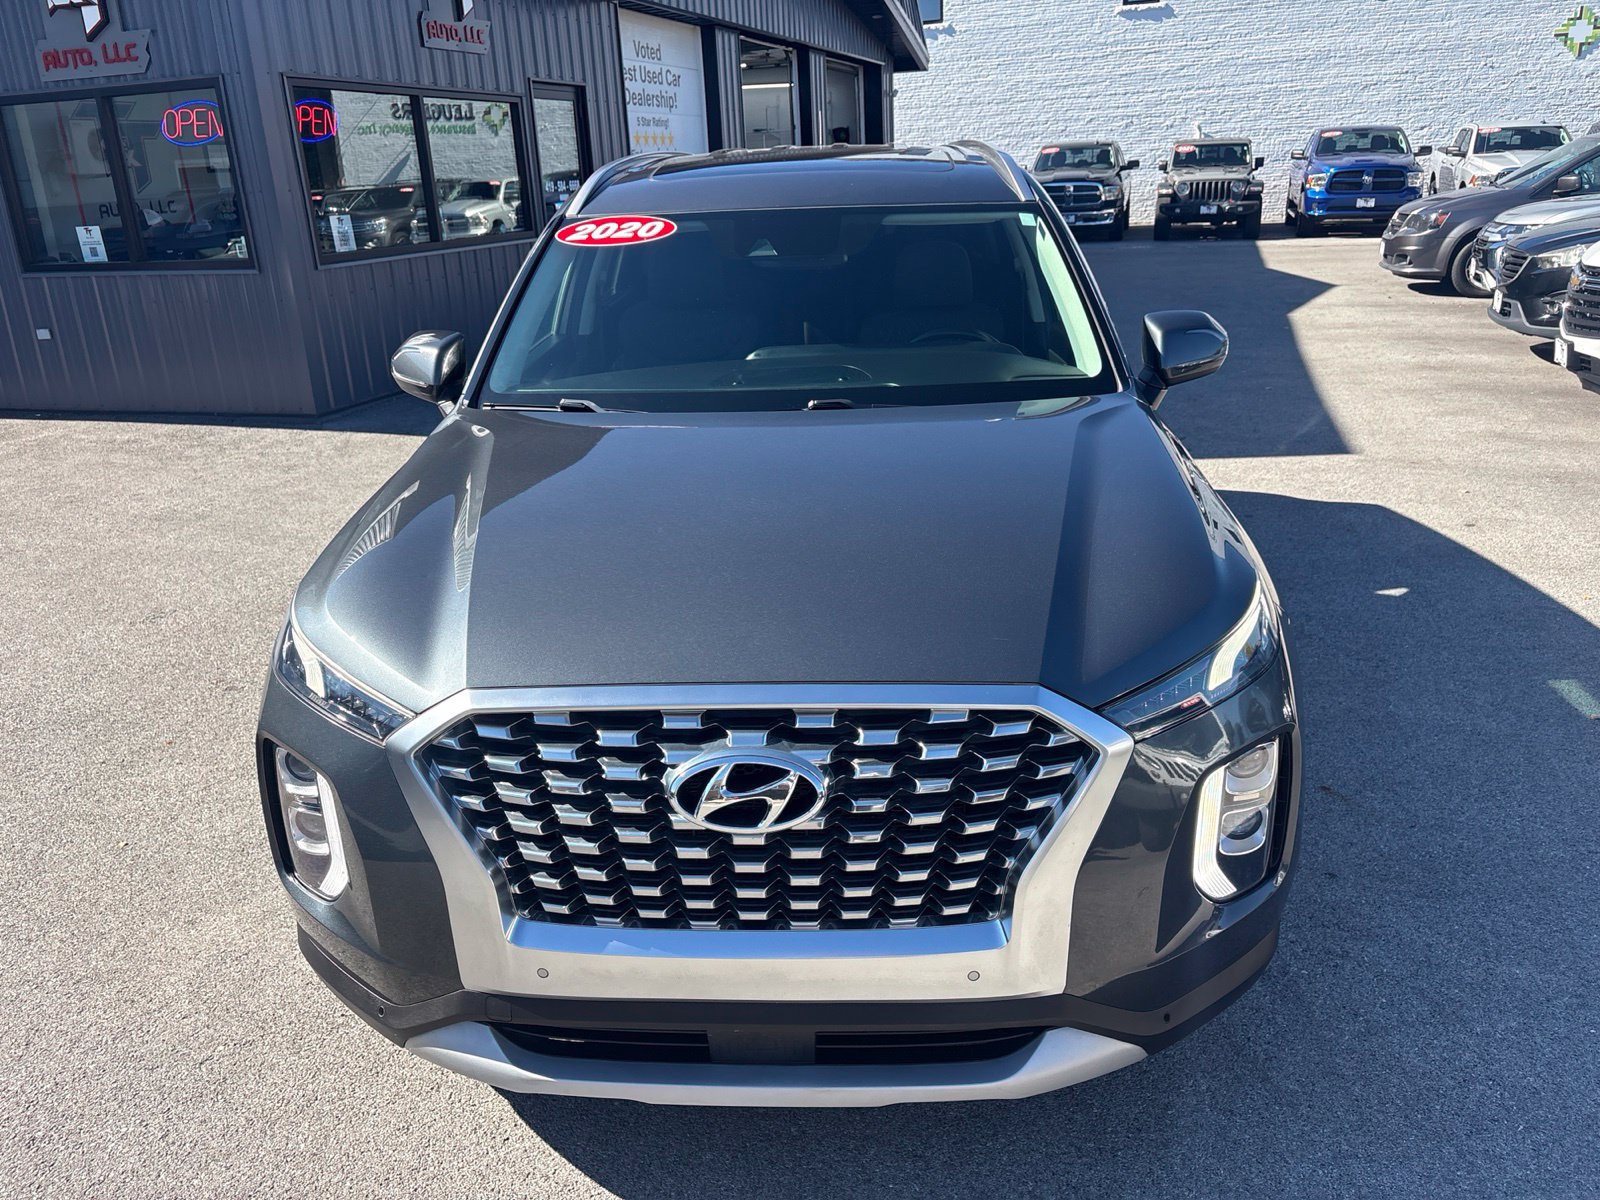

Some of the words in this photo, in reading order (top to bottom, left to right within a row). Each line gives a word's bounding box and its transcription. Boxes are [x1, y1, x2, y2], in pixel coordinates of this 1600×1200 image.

[426, 20, 462, 42] AUTO,
[463, 25, 485, 45] LLC
[42, 48, 98, 72] AUTO,
[101, 42, 139, 64] LLC
[633, 39, 662, 61] Voted
[623, 64, 637, 82] est
[639, 64, 663, 85] Used
[665, 68, 681, 87] Car
[625, 87, 678, 112] Dealership!
[163, 107, 224, 139] OPEN
[641, 116, 652, 127] Star
[565, 221, 665, 241] 2020
